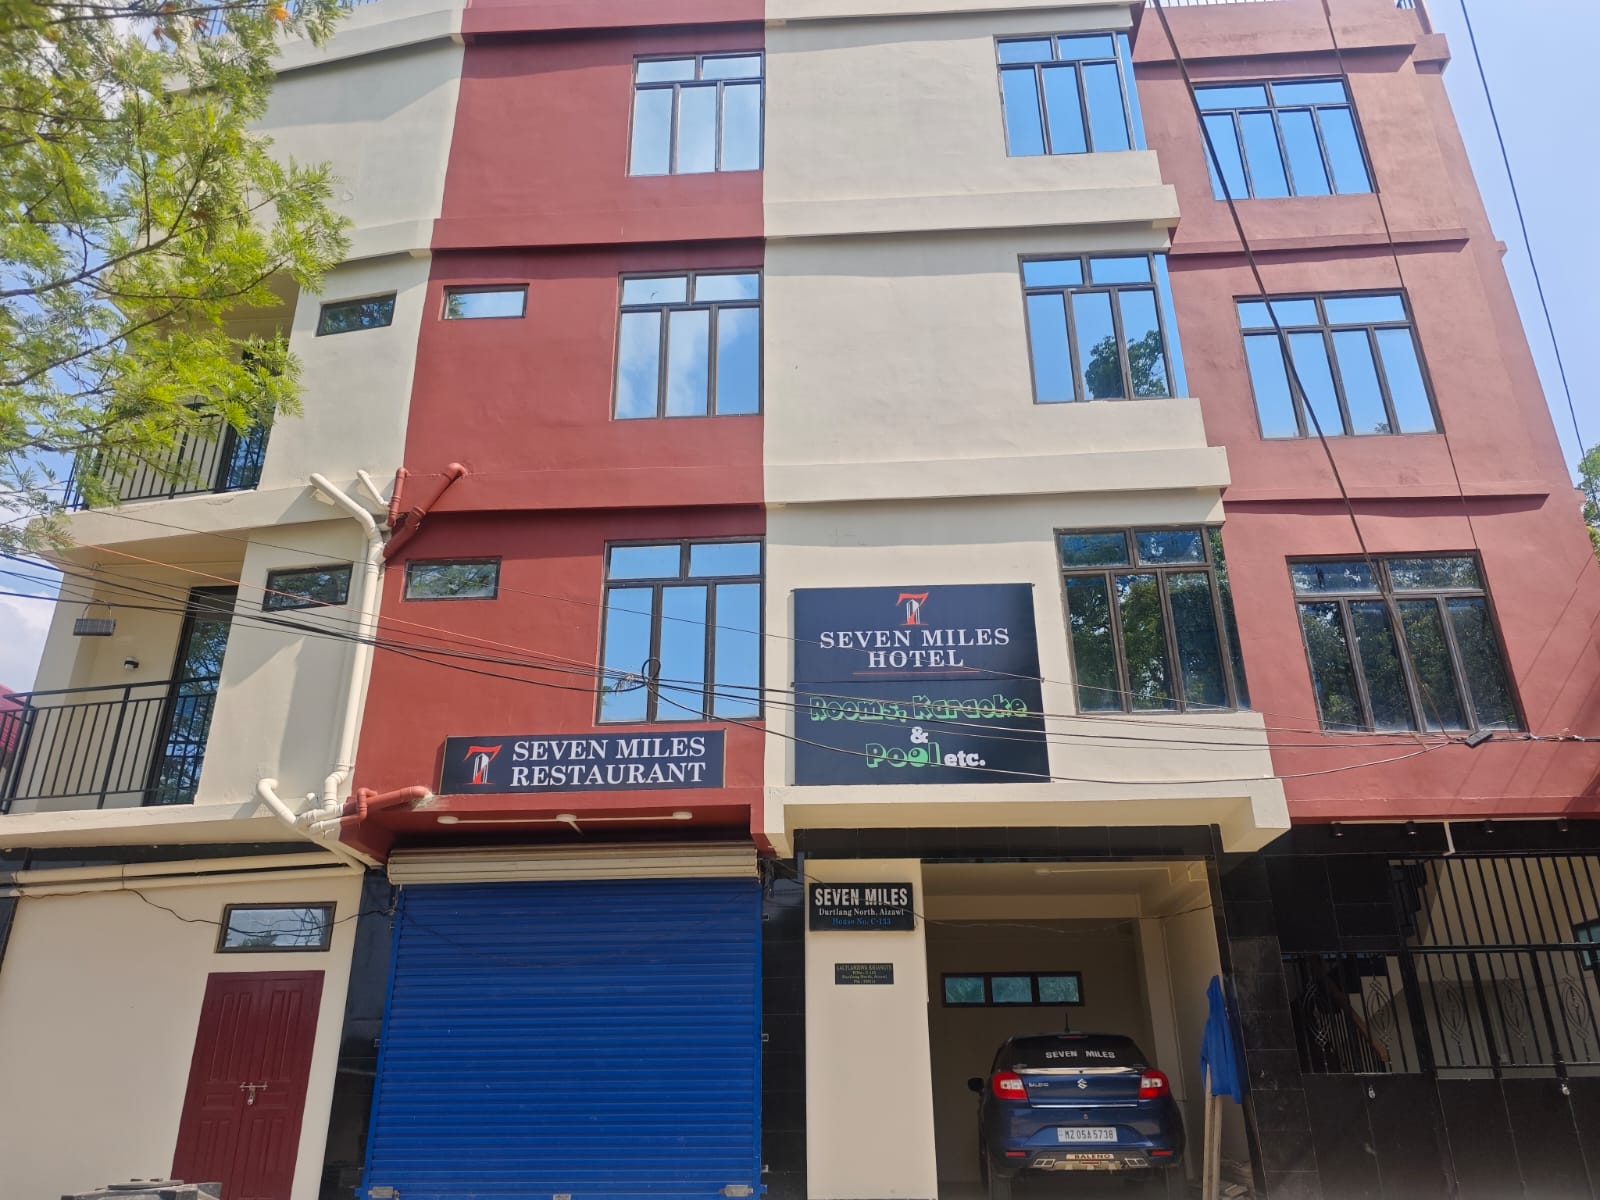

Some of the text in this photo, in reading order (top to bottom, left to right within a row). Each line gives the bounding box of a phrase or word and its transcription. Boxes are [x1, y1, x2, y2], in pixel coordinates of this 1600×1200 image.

[820, 628, 1010, 649] SEVEN MILES
[868, 649, 964, 668] HOTEL
[810, 694, 1028, 721] Rooms, Karaoke
[910, 726, 929, 744] &
[512, 736, 706, 761] SEVEN MILES
[865, 742, 986, 768] Pool etc.
[510, 762, 706, 787] RESTAURANT
[815, 888, 908, 906] SEVEN MILES
[819, 908, 852, 917] Durtlang
[1045, 1050, 1116, 1059] SEVEN MILES
